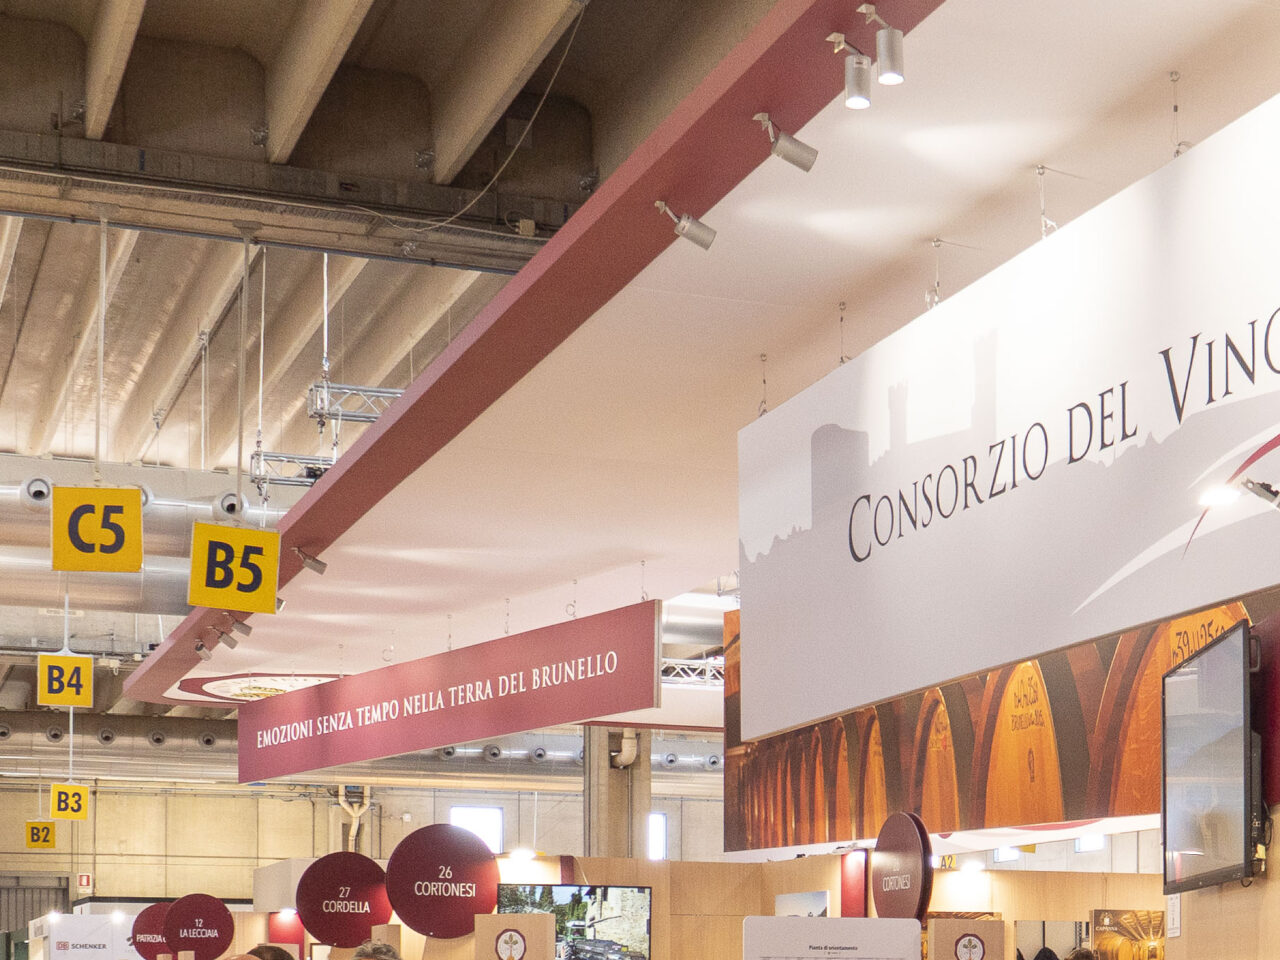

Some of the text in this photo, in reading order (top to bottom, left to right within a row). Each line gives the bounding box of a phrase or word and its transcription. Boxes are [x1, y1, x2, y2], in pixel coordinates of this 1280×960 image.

[1066, 380, 1138, 466] DEL
[67, 503, 126, 554] C5
[204, 539, 265, 594] B5
[46, 664, 84, 696] B4
[256, 650, 618, 749] EMOZIONI SENZA TEMPO NELLA TERRA DEL BRUNELLO
[57, 790, 82, 813] B3
[30, 826, 51, 843] B2
[940, 854, 953, 869] A2
[438, 865, 453, 879] 26
[338, 886, 351, 898] 27
[414, 881, 476, 898] CORTONESI
[322, 900, 371, 914] CORDELLA
[194, 918, 203, 928] 12
[136, 934, 163, 943] PATRIZIA
[179, 928, 219, 939] LA LECCIAIA
[71, 942, 107, 950] SCHENKER
